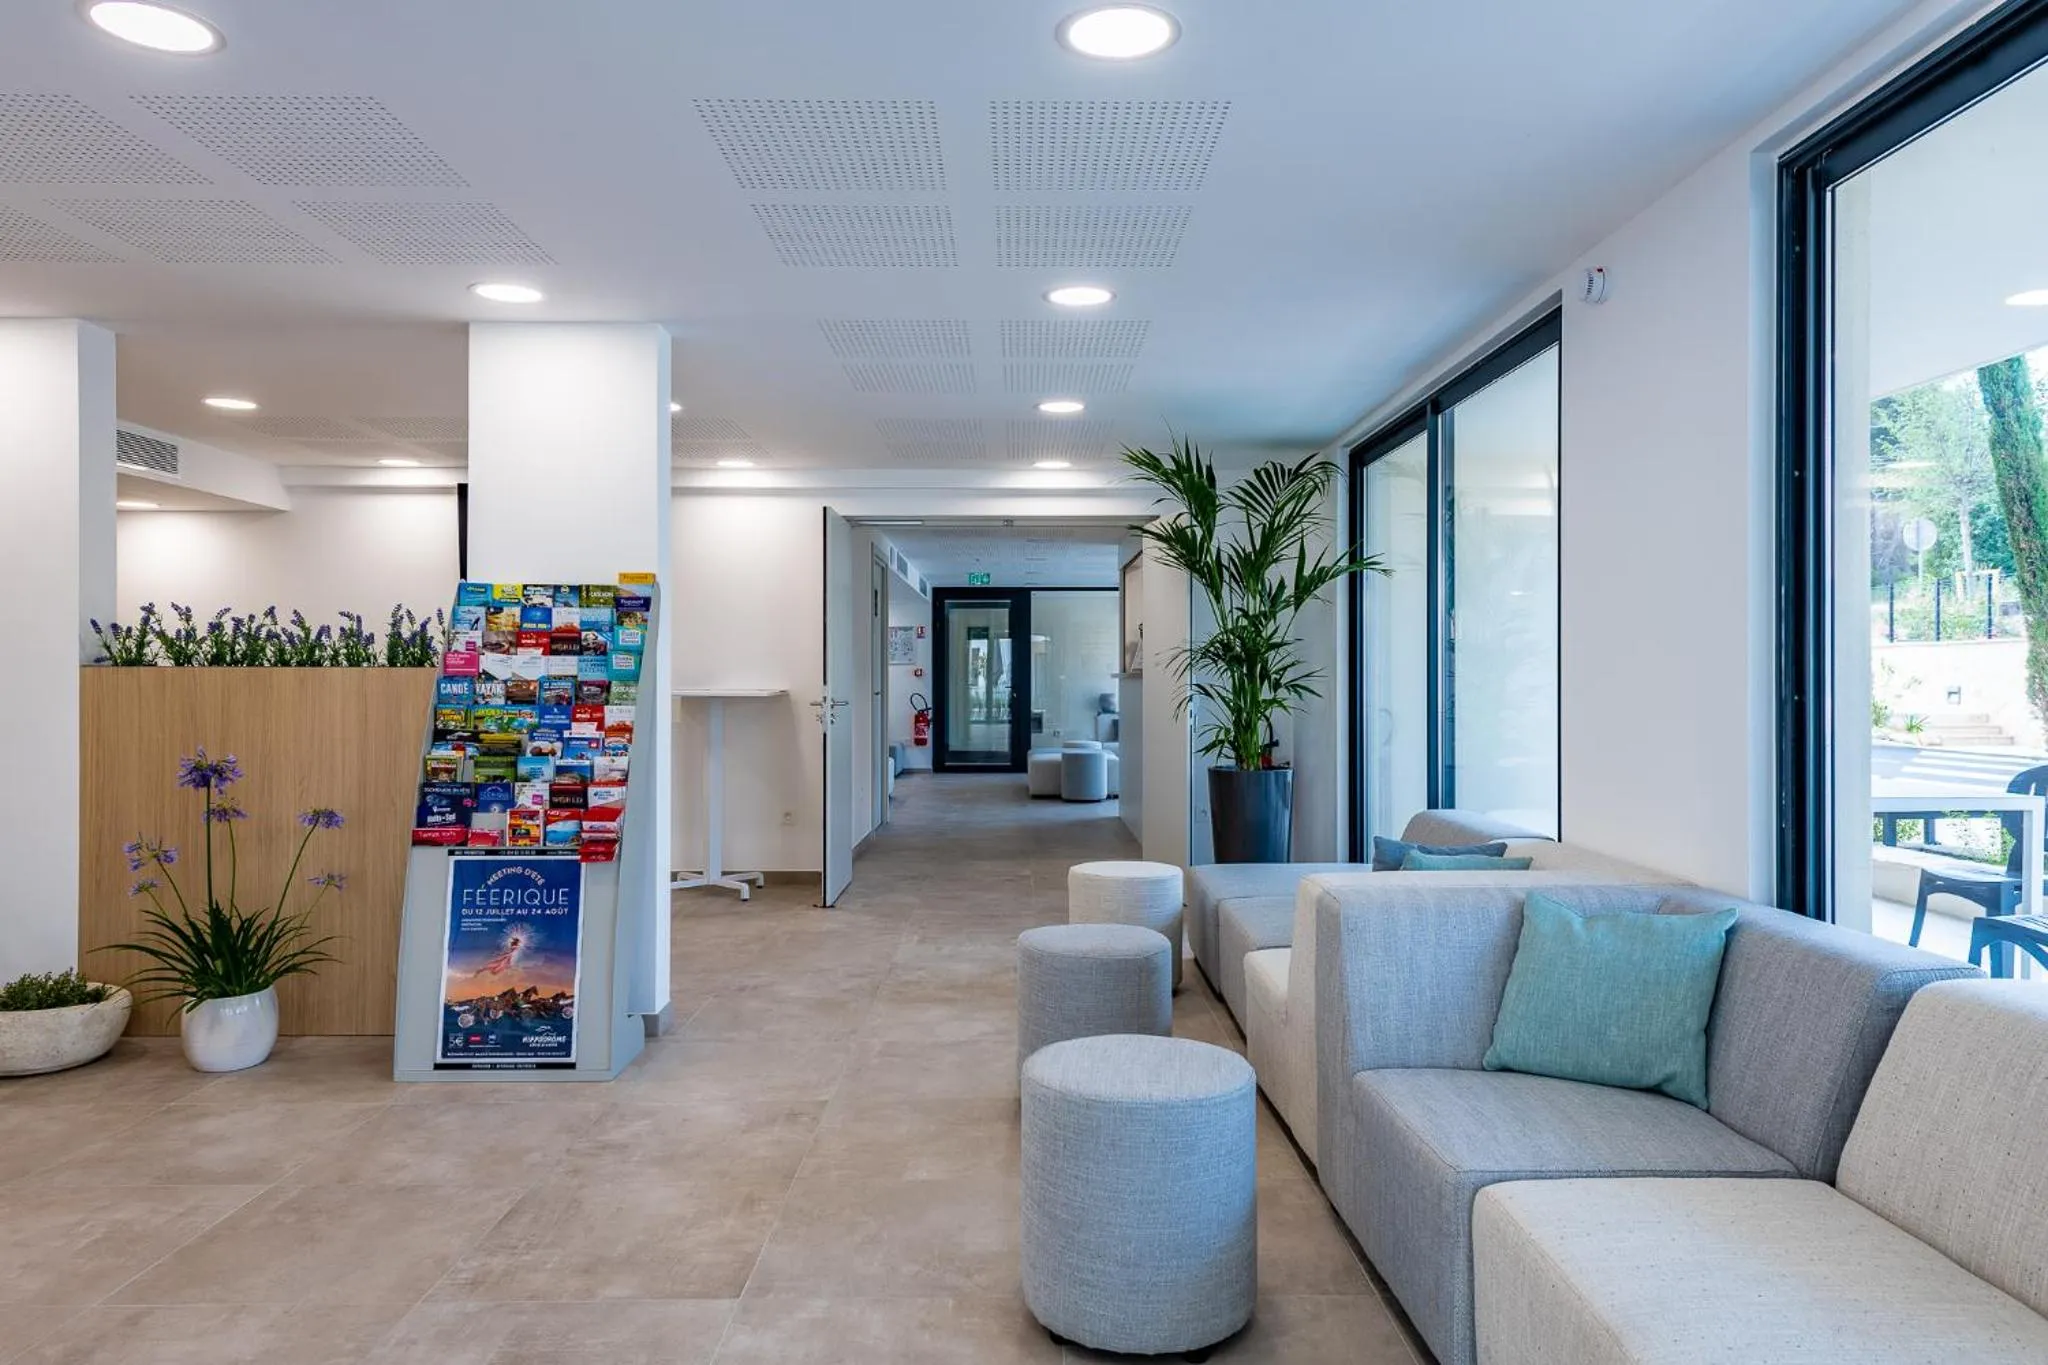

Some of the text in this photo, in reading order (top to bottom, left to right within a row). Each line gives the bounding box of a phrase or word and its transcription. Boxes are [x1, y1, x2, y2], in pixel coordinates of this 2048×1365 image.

[487, 866, 523, 885] MEETING
[462, 883, 569, 906] FÉERIQUE
[461, 908, 473, 916] DU
[475, 908, 483, 916] 12
[485, 908, 514, 916] JUILLET
